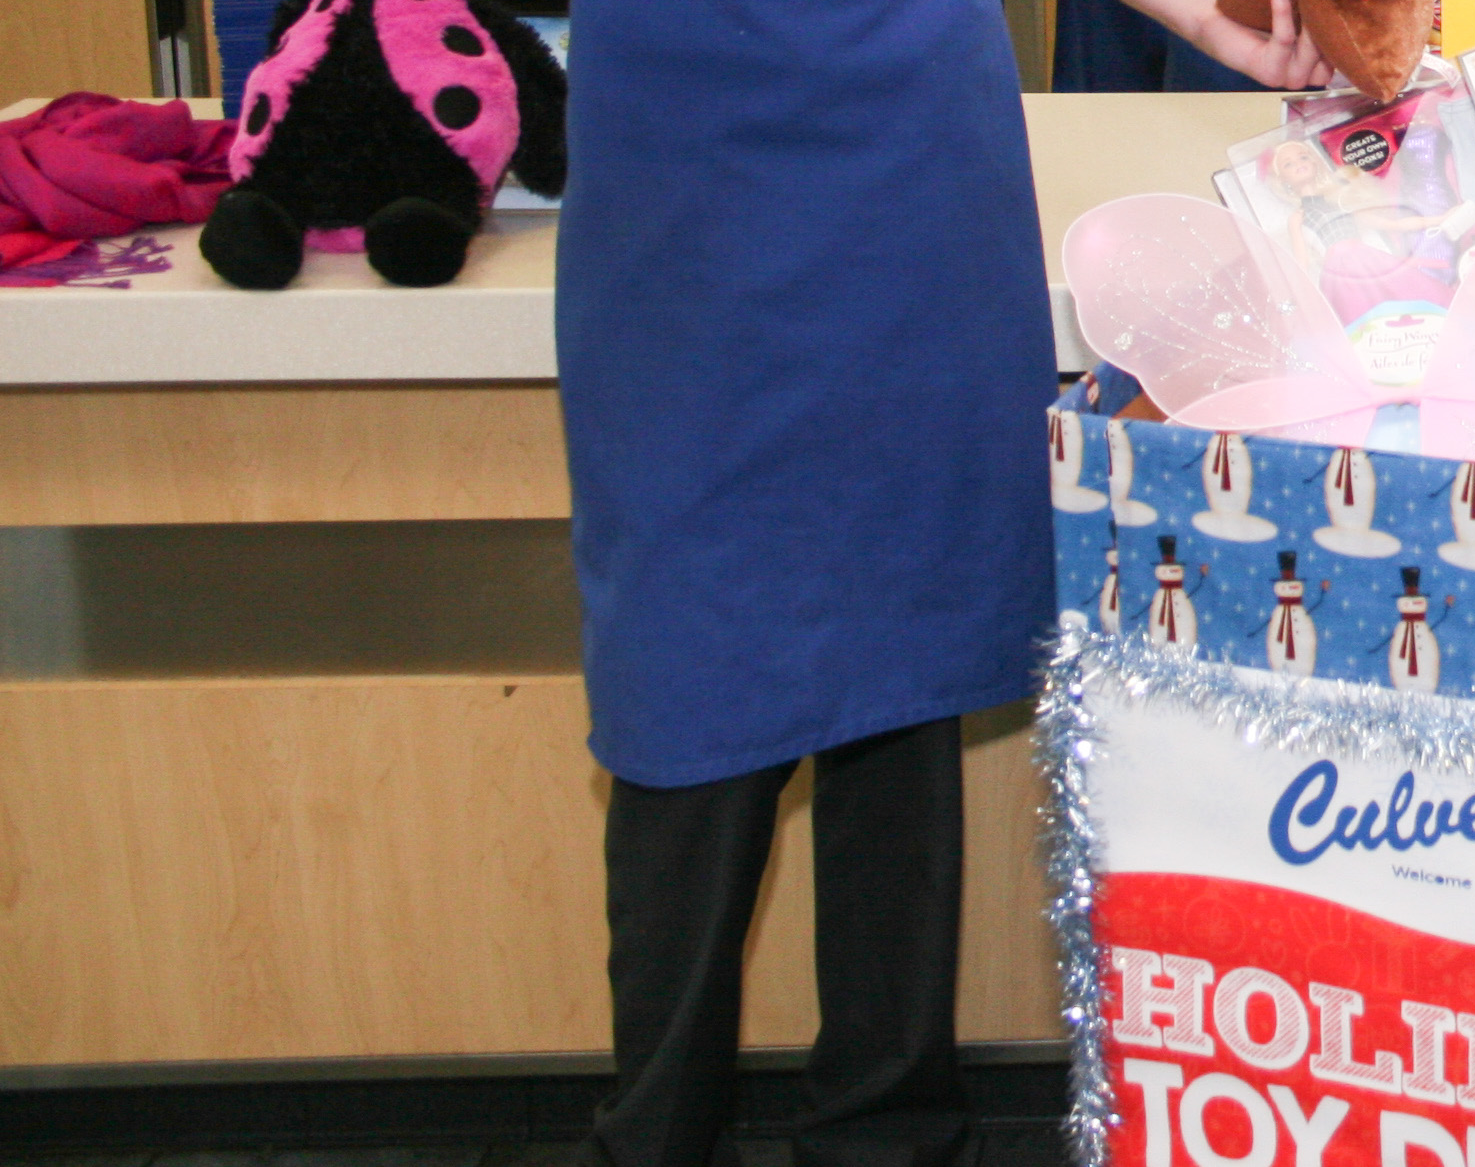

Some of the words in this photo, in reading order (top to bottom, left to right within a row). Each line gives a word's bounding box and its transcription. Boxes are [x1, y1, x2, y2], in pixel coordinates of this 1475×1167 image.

[1343, 149, 1367, 165] YOUR
[1365, 139, 1388, 154] OWN
[1345, 135, 1377, 152] CREATE
[1354, 151, 1385, 167] LOOKS!
[1392, 865, 1472, 889] Welcome
[1123, 1057, 1351, 1167] TOY
